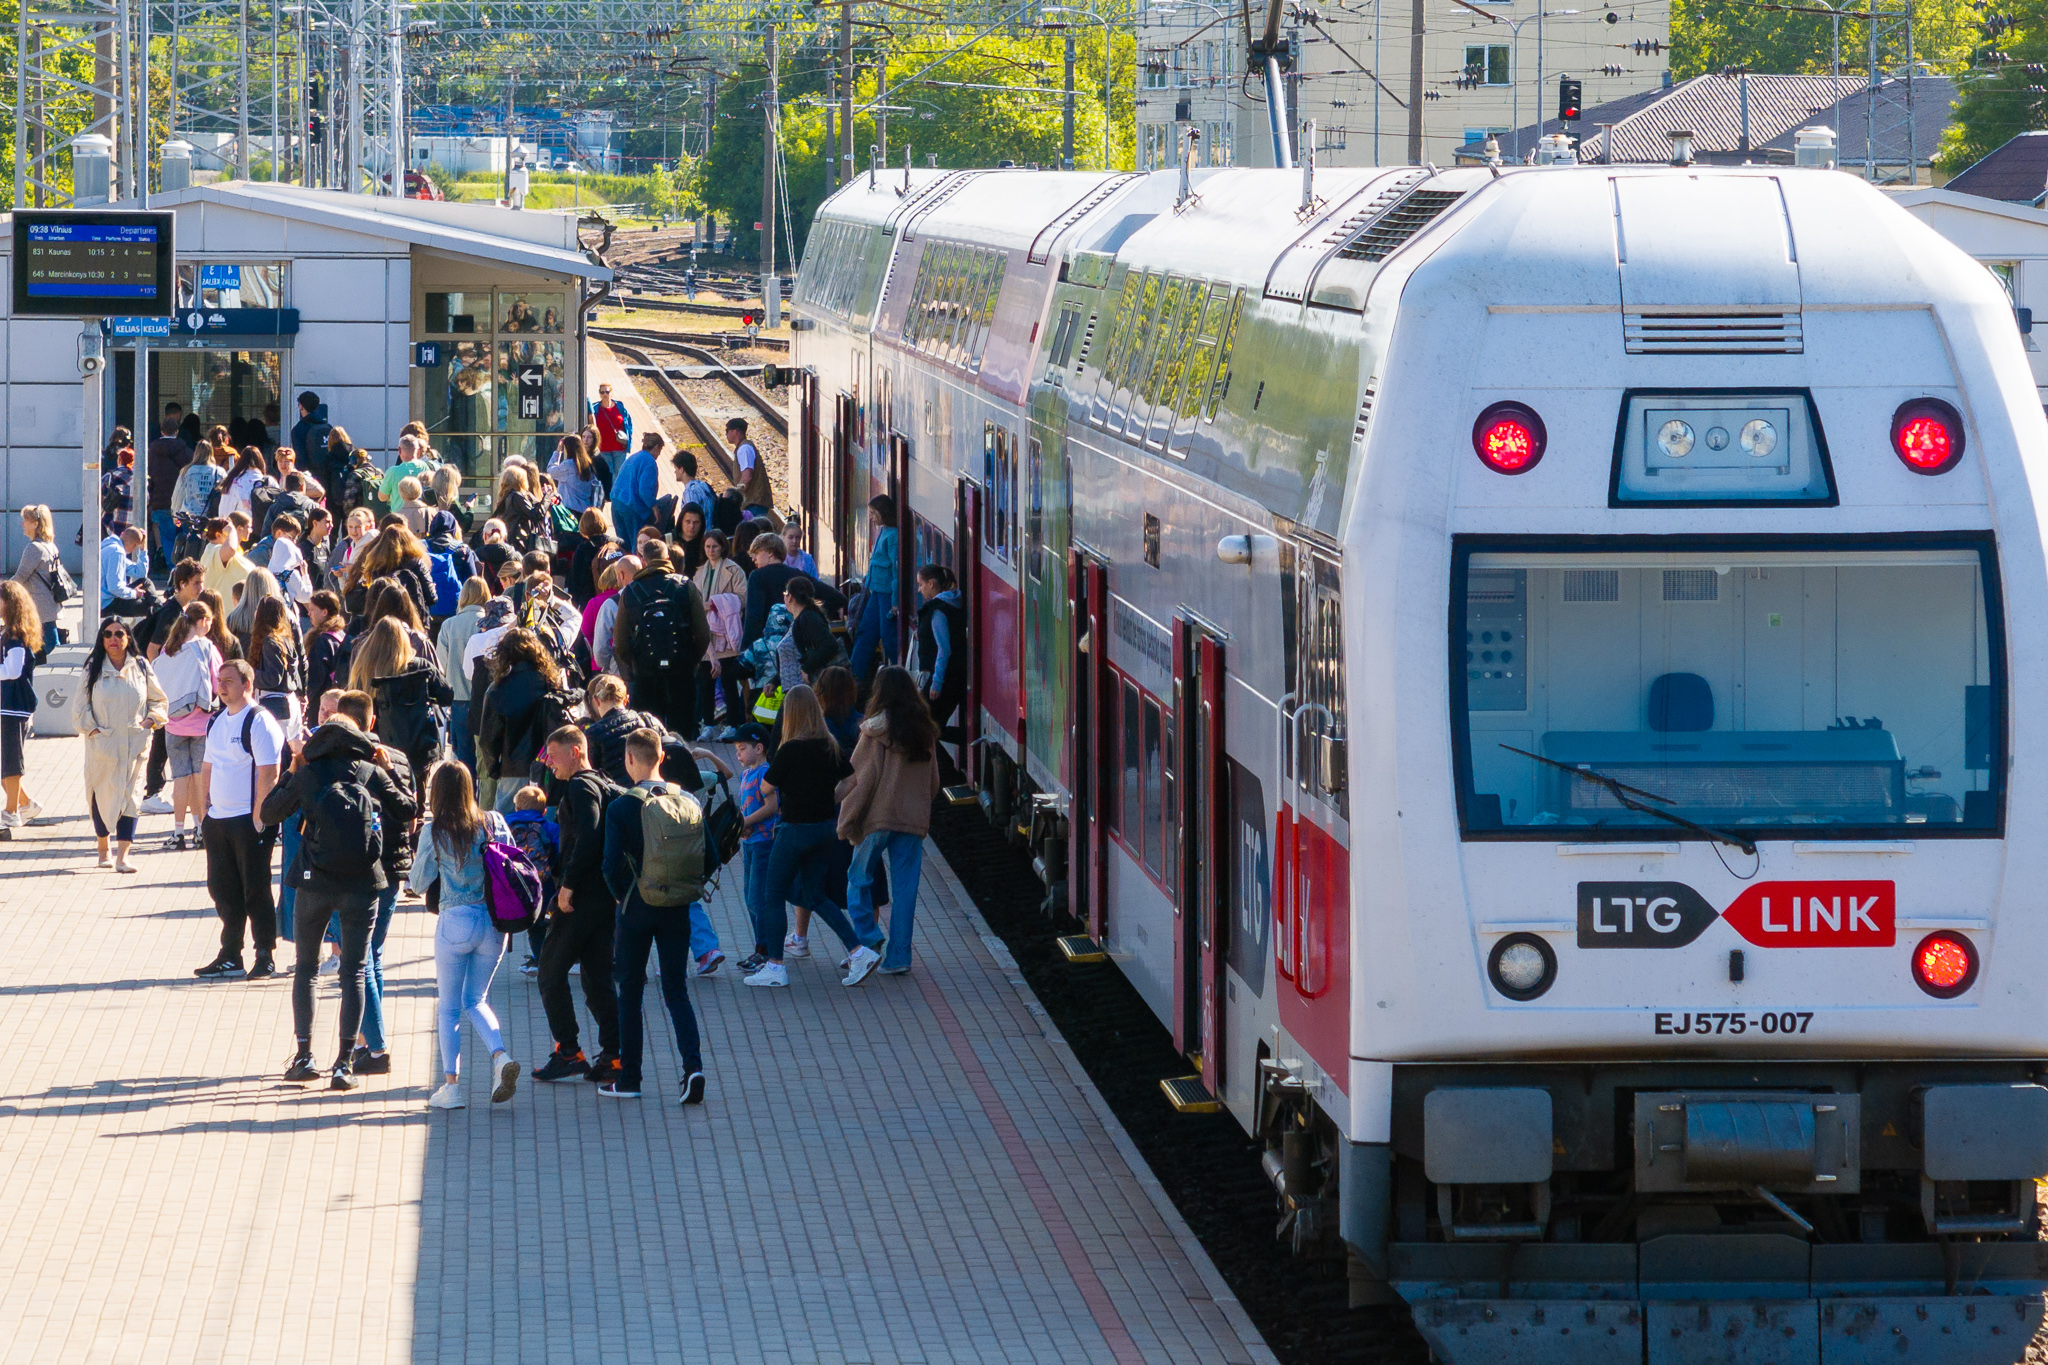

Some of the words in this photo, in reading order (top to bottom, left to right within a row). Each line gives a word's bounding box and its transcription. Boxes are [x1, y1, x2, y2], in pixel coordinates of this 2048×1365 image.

[30, 225, 49, 234] 09:38
[50, 225, 72, 234] Vilnius
[120, 226, 156, 235] Departures
[32, 248, 44, 256] 831
[48, 248, 71, 256] Kaunas
[110, 248, 115, 257] 2
[124, 248, 129, 256] 4
[32, 270, 45, 278] 645
[110, 271, 115, 279] 2
[123, 271, 129, 279] 3
[115, 325, 140, 333] KELIAS
[143, 325, 168, 333] KELIAS
[1241, 818, 1263, 946] LTG
[1592, 896, 1682, 933] LTG
[1760, 895, 1882, 933] LINK
[1654, 1011, 1815, 1036] EJ575-007
